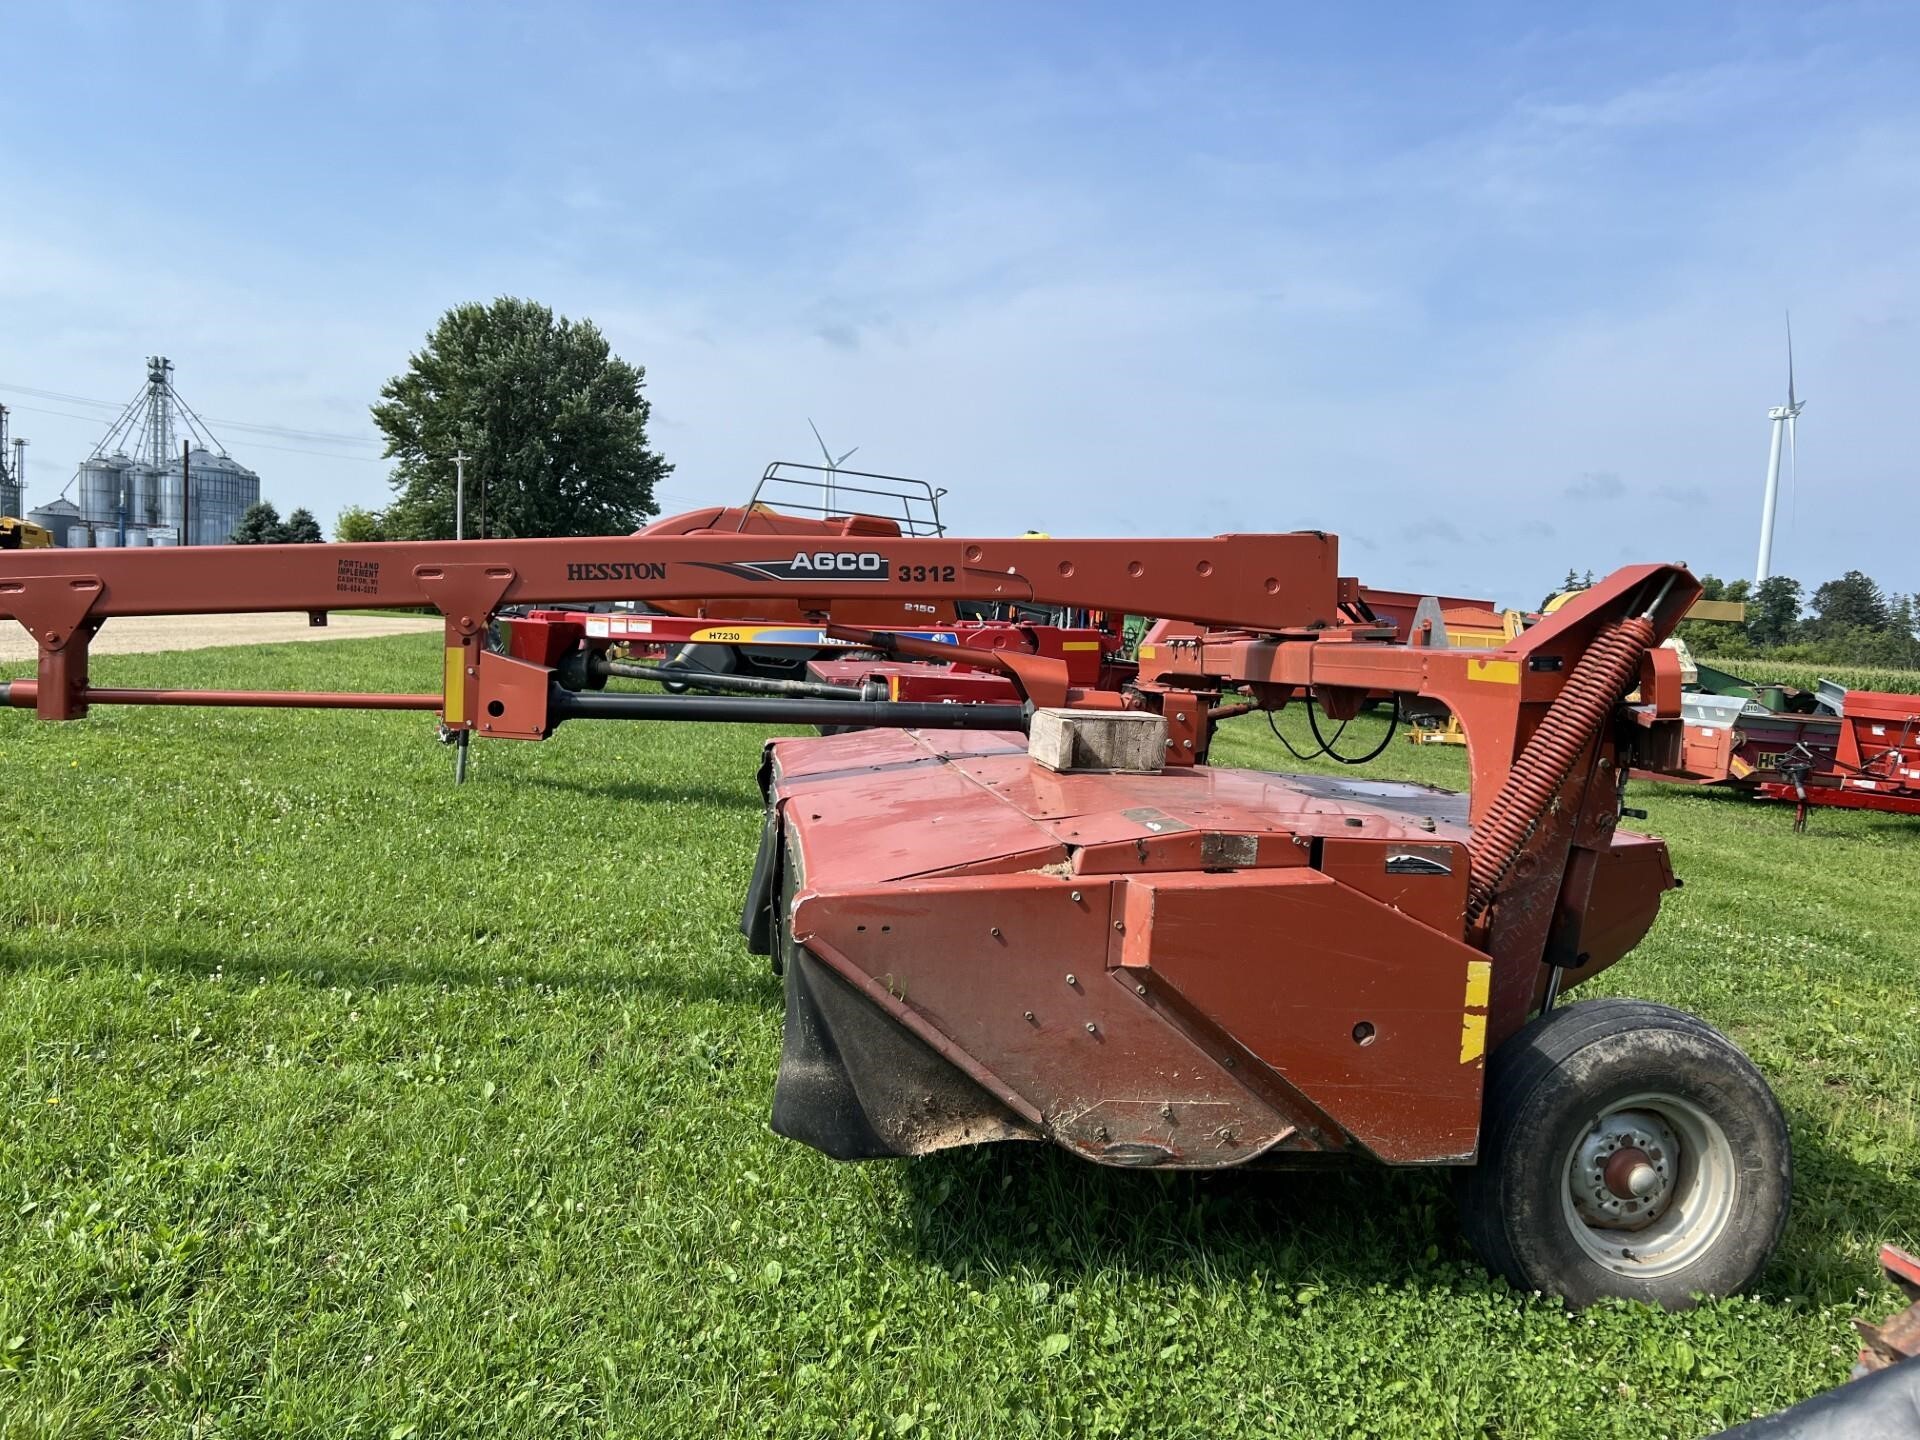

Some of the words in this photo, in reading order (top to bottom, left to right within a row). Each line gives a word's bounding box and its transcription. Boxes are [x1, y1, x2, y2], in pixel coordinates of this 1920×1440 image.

[338, 560, 379, 570] PORTLAND
[567, 562, 666, 580] HESSTON
[790, 552, 881, 571] AGCO
[899, 565, 955, 582] 3312
[338, 567, 378, 578] IMPLEMENT
[904, 603, 936, 613] 2150
[709, 632, 740, 640] H7230
